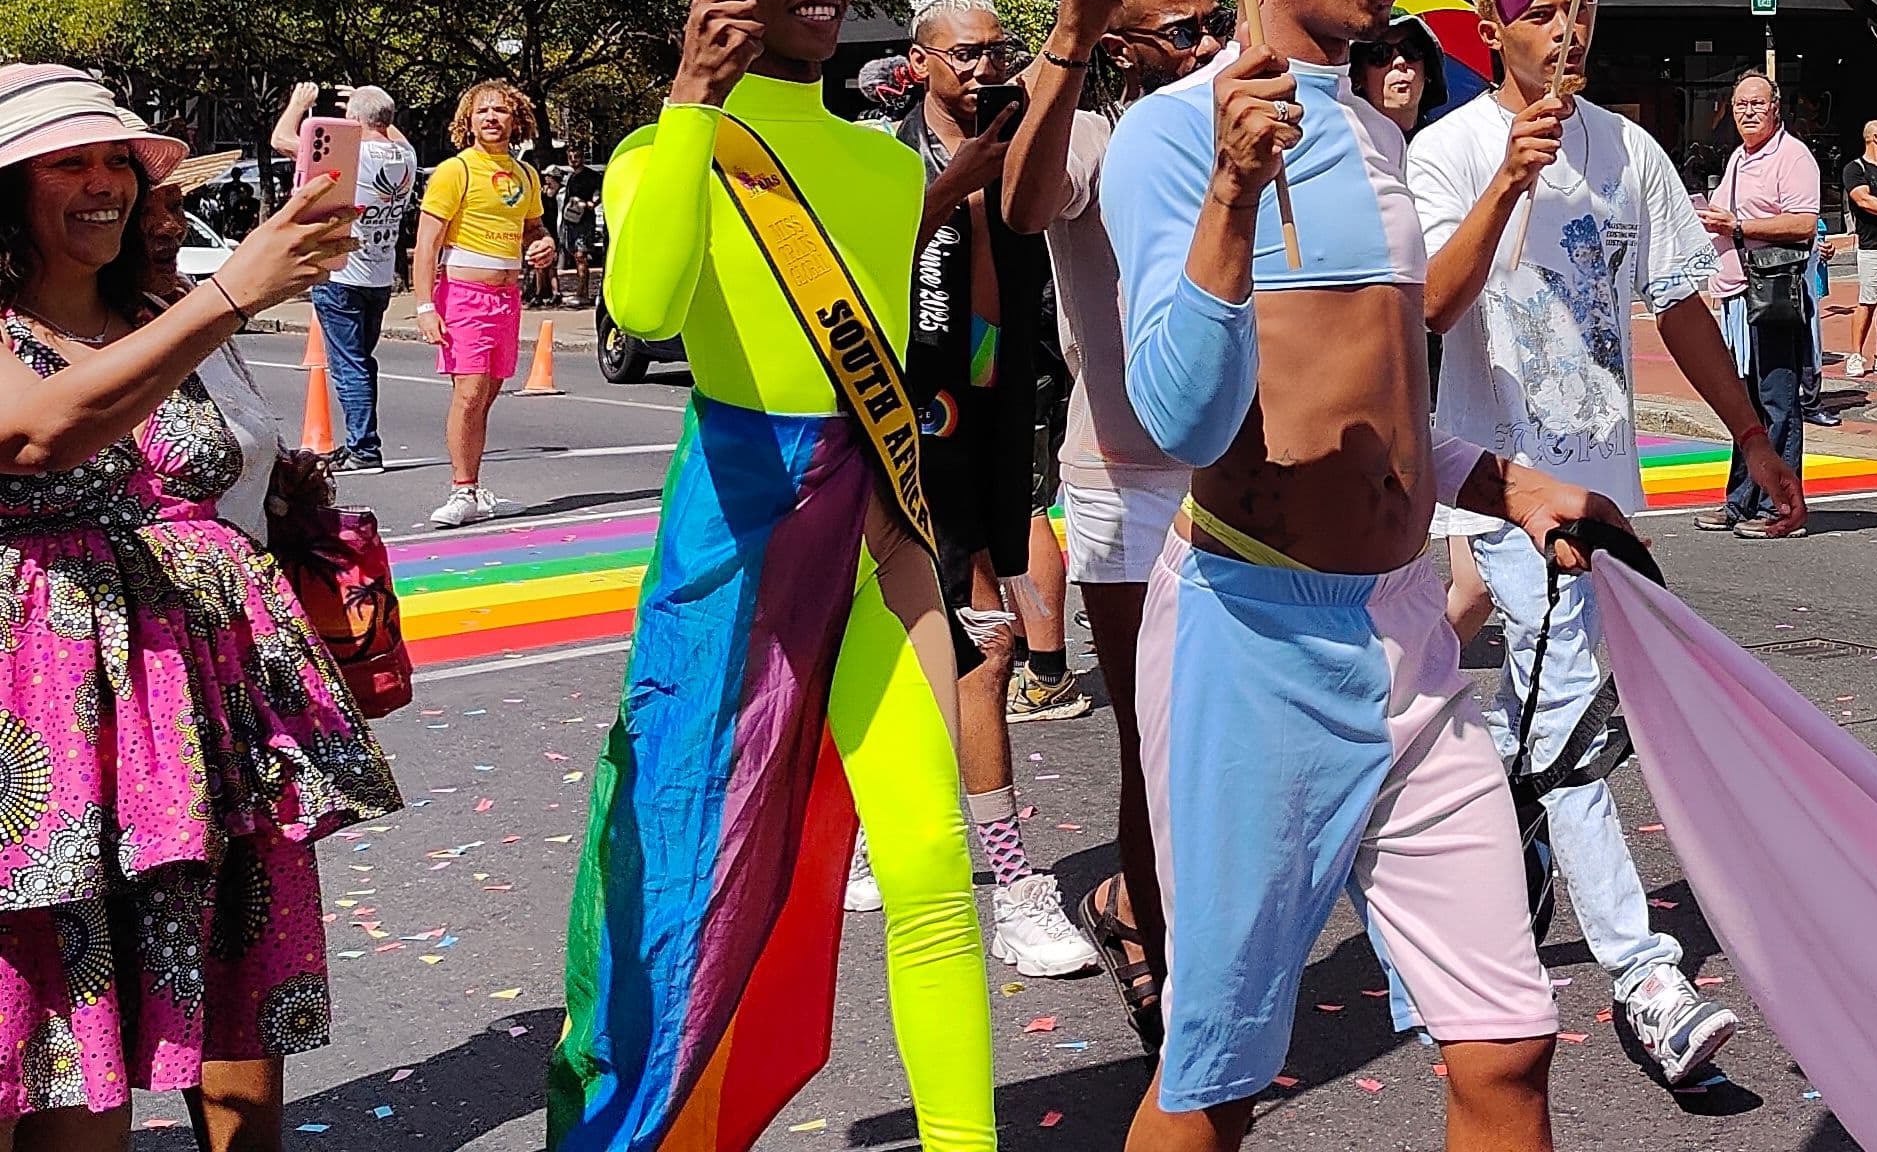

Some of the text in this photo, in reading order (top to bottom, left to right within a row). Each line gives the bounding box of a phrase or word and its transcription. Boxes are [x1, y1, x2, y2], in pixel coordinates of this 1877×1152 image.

[919, 289, 950, 333] 2025
[815, 298, 933, 534] SOUTH AFRICA
